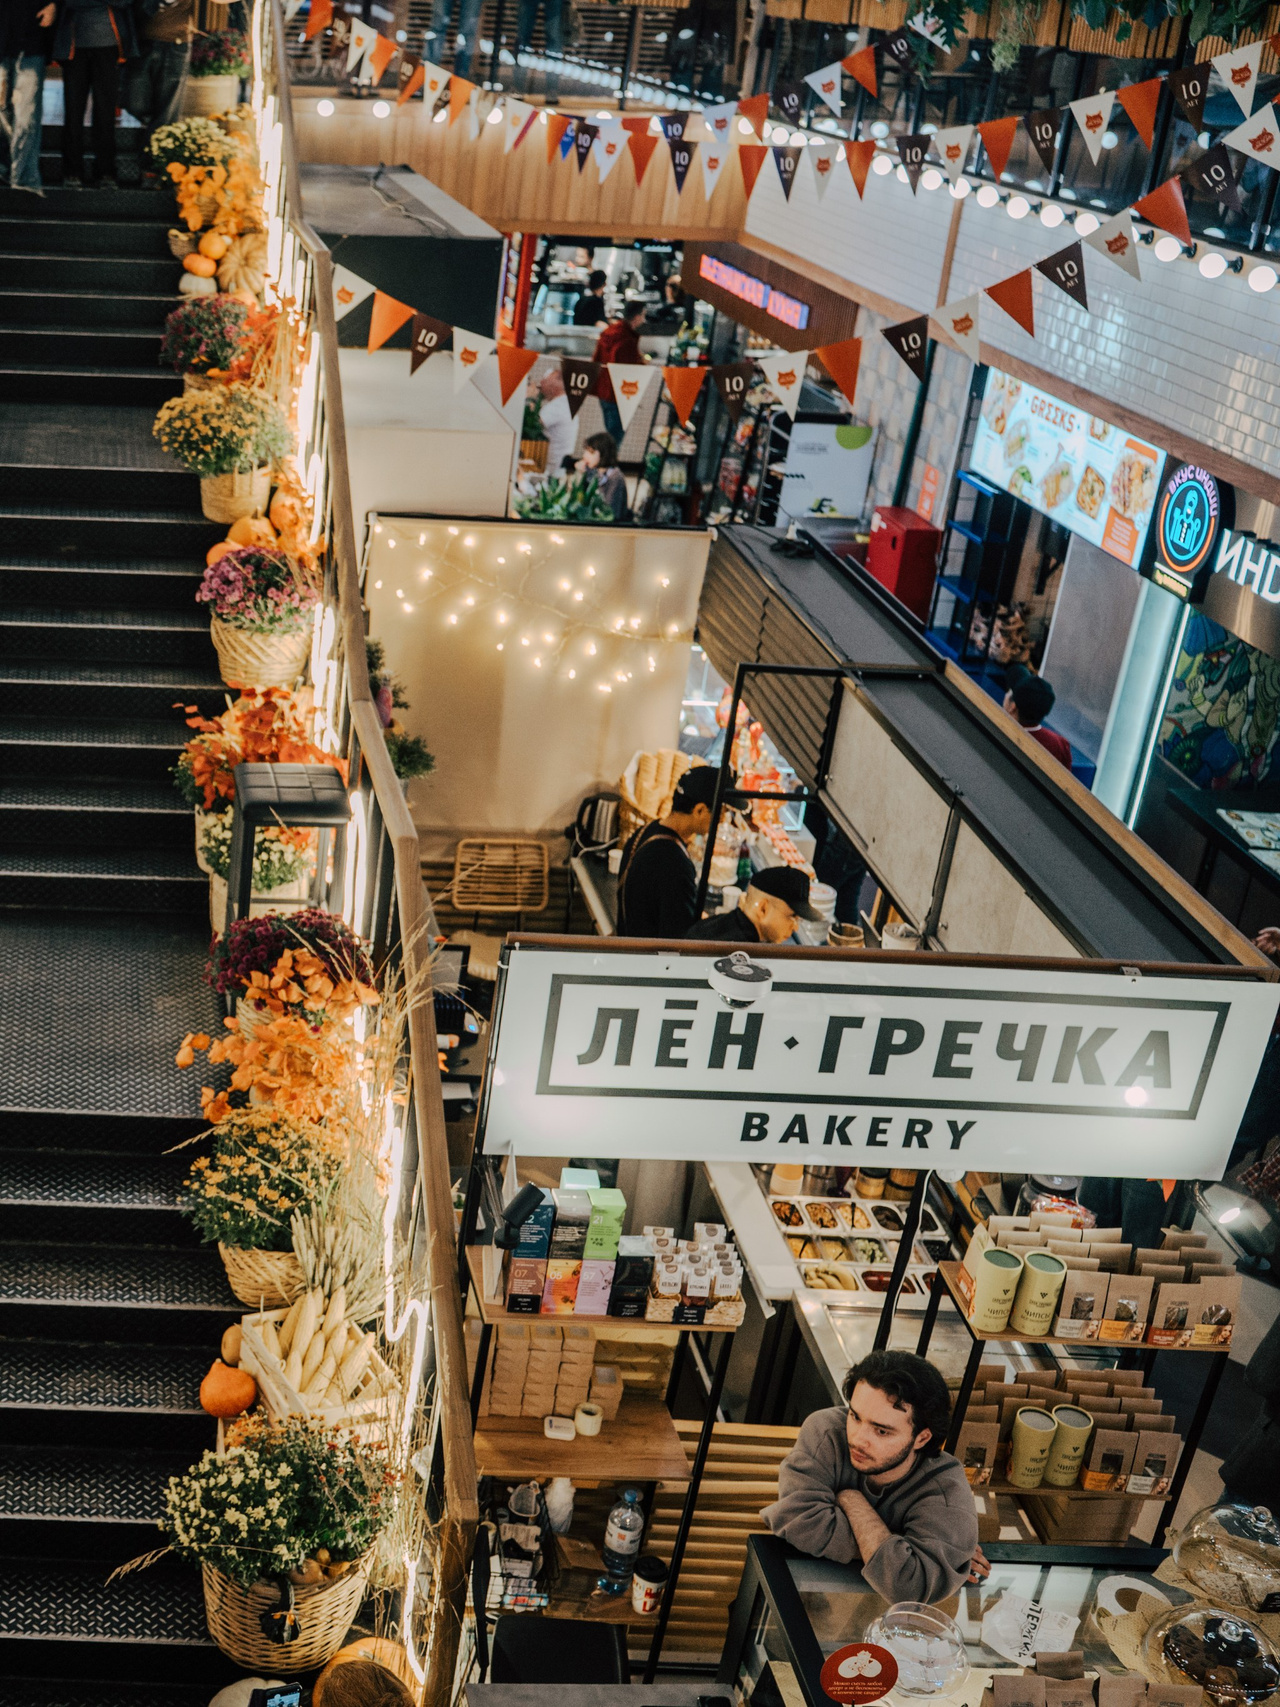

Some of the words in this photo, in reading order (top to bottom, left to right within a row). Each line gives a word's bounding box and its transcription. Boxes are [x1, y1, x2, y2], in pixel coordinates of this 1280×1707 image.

[891, 38, 908, 55] 10
[1182, 80, 1201, 99] 10
[783, 93, 798, 107] 10
[668, 123, 682, 136] 10
[1035, 123, 1052, 140] 10
[675, 151, 688, 164] 10
[906, 147, 921, 162] 10
[780, 157, 793, 171] 10
[1202, 165, 1225, 187] 10
[1056, 260, 1078, 282] 10
[417, 328, 437, 347] 10
[900, 333, 921, 352] 10
[570, 372, 588, 389] 10
[725, 376, 744, 392] 10
[818, 1015, 1172, 1089] ГРЕЧКА
[740, 1112, 977, 1150] BAKERY
